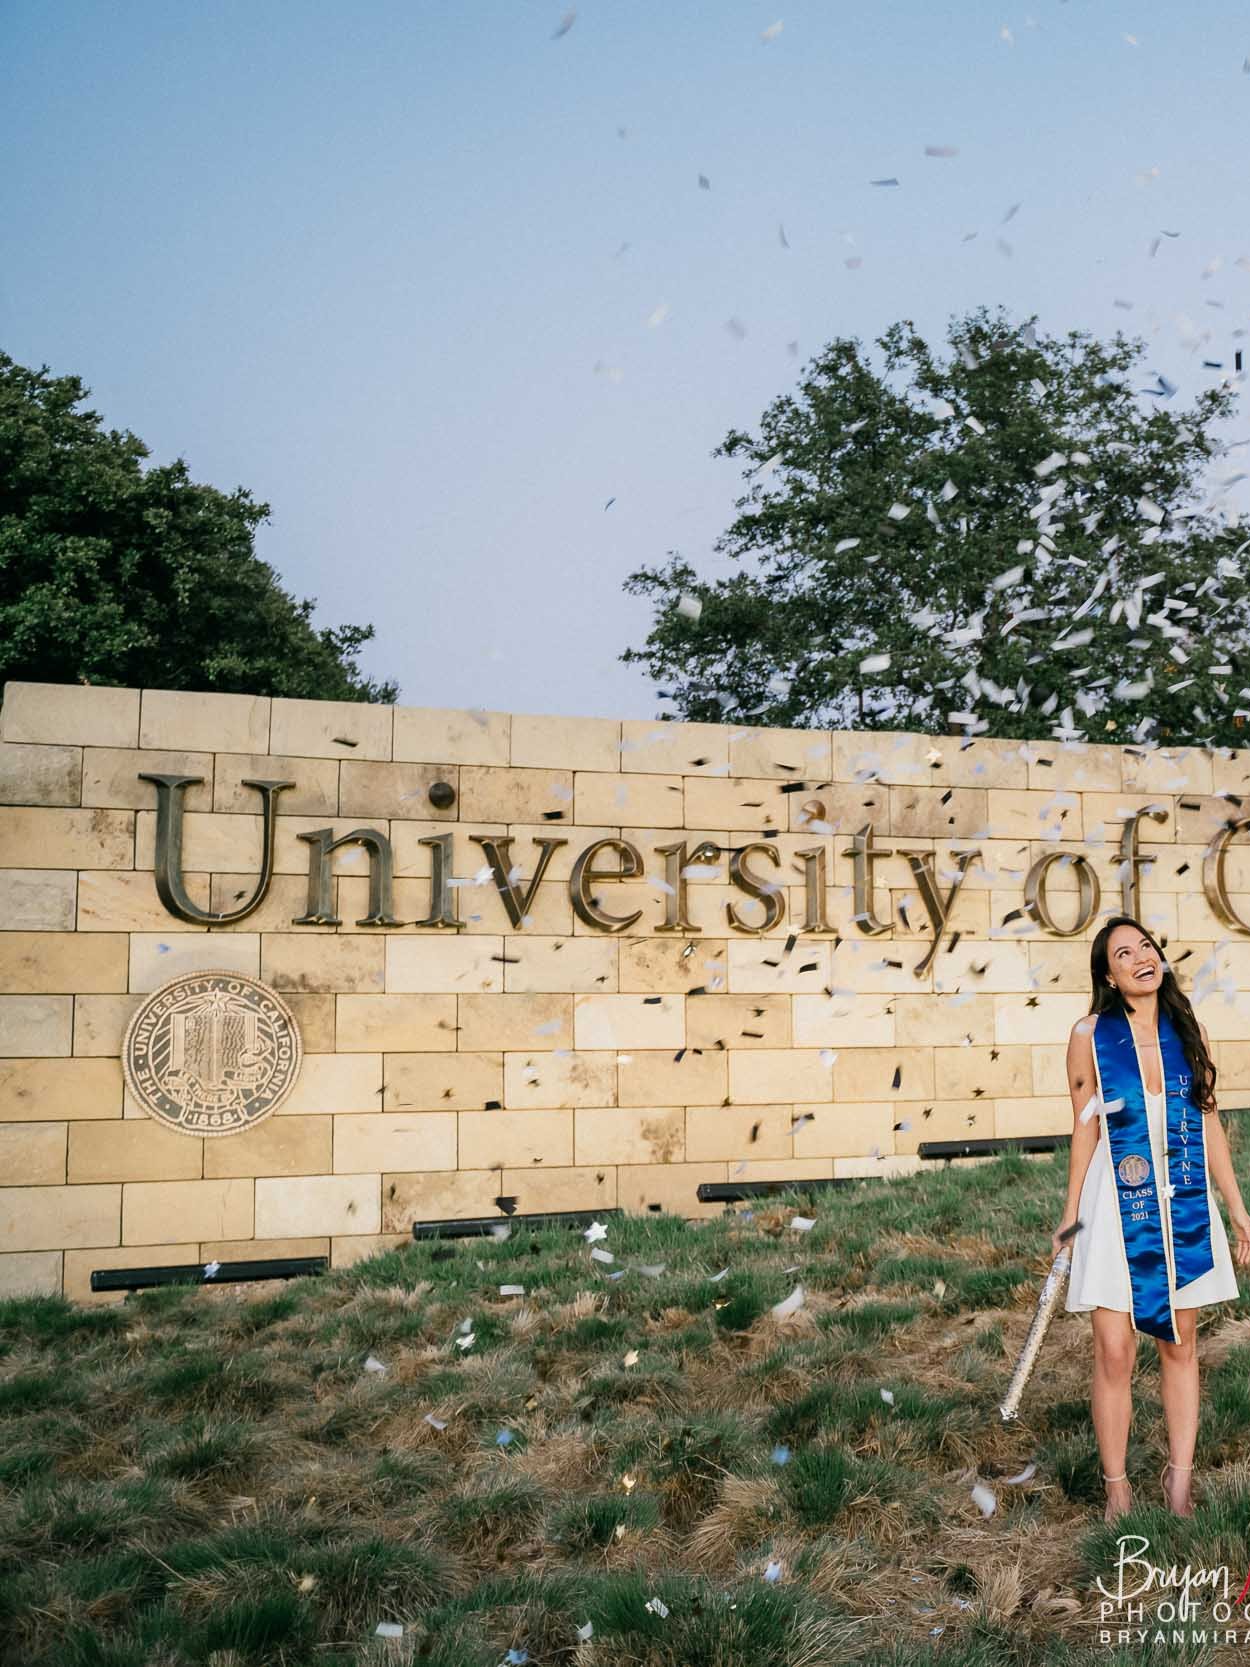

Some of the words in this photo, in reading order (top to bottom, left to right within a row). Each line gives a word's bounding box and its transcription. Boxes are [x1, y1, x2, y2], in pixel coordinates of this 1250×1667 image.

[138, 773, 983, 979] University
[1024, 804, 1169, 936] of
[228, 982, 254, 998] OF
[134, 980, 216, 1056] UNIVERSITY
[259, 1001, 291, 1100] CALIFORNIA
[137, 1070, 162, 1104] THE
[1178, 1074, 1189, 1099] UC
[192, 1112, 234, 1126] 1868
[1179, 1107, 1192, 1185] IRVINE
[1122, 1187, 1153, 1200] CLASS
[1131, 1200, 1146, 1210] OF
[1130, 1211, 1149, 1222] 2021
